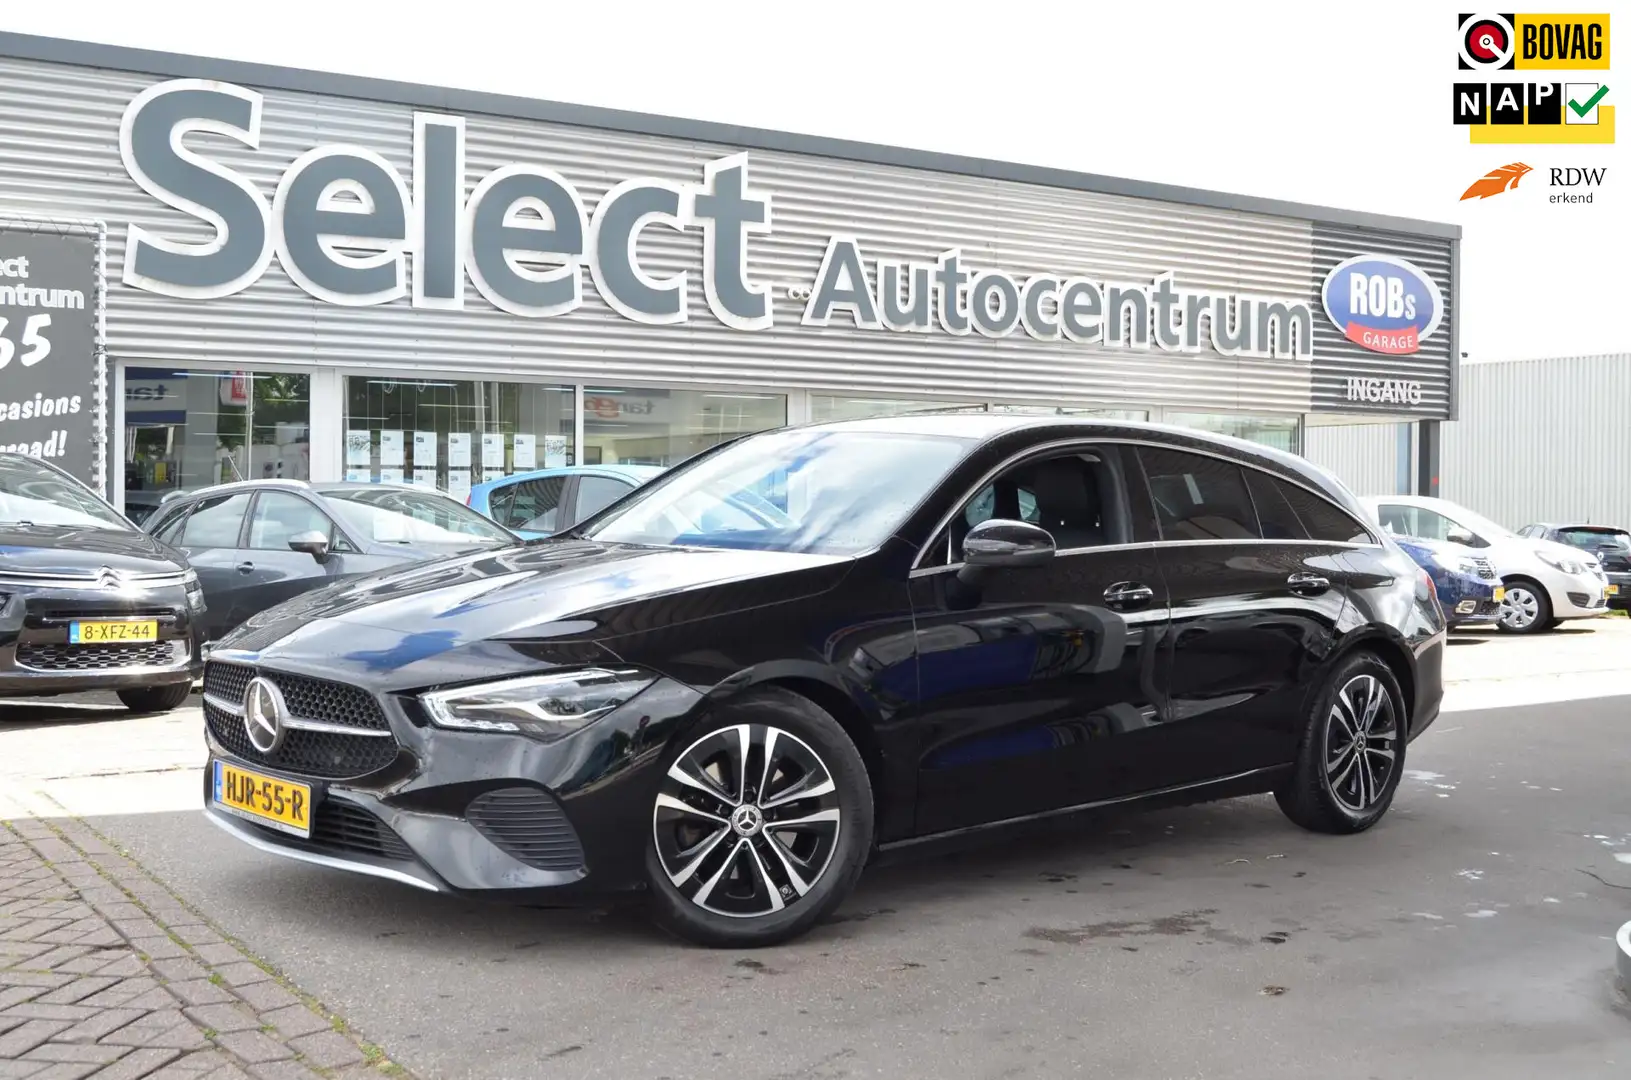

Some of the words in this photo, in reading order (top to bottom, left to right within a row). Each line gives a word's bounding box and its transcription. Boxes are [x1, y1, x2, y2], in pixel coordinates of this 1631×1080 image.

[119, 78, 773, 331] Select
[801, 233, 1314, 361] Autocentrum
[0, 256, 29, 278] ct
[1362, 331, 1415, 349] GARAGE
[1346, 376, 1422, 406] INGANG
[84, 624, 150, 640] 8-XFZ-44
[226, 770, 304, 822] HJR-55-R
